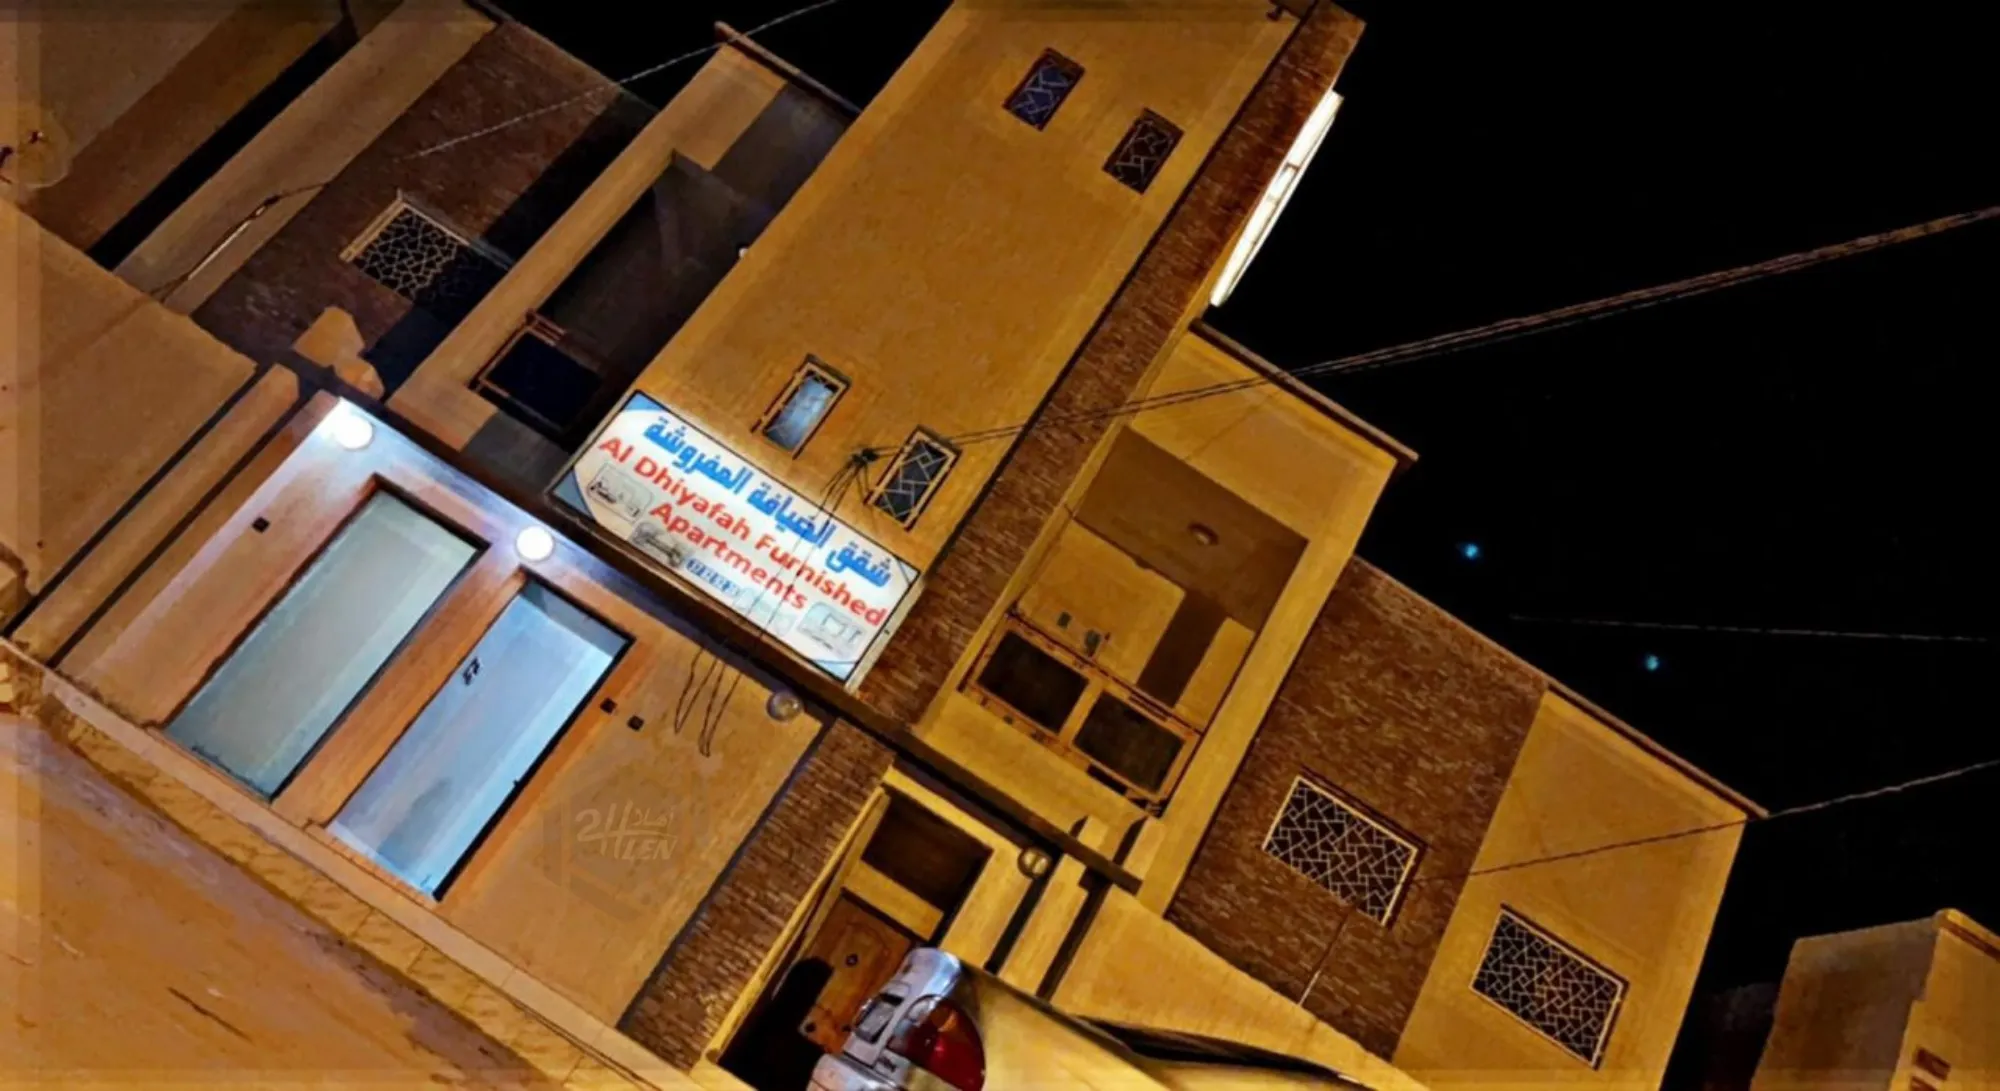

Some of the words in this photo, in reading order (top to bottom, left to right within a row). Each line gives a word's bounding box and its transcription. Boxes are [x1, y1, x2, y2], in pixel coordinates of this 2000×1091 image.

[643, 415, 754, 493] المفروشة
[599, 436, 635, 466] Al
[634, 456, 751, 540] Dhiyafah
[755, 536, 888, 626] Furnished
[746, 481, 835, 546] الضيافة
[650, 502, 808, 610] Apartments
[826, 541, 892, 589] شقق
